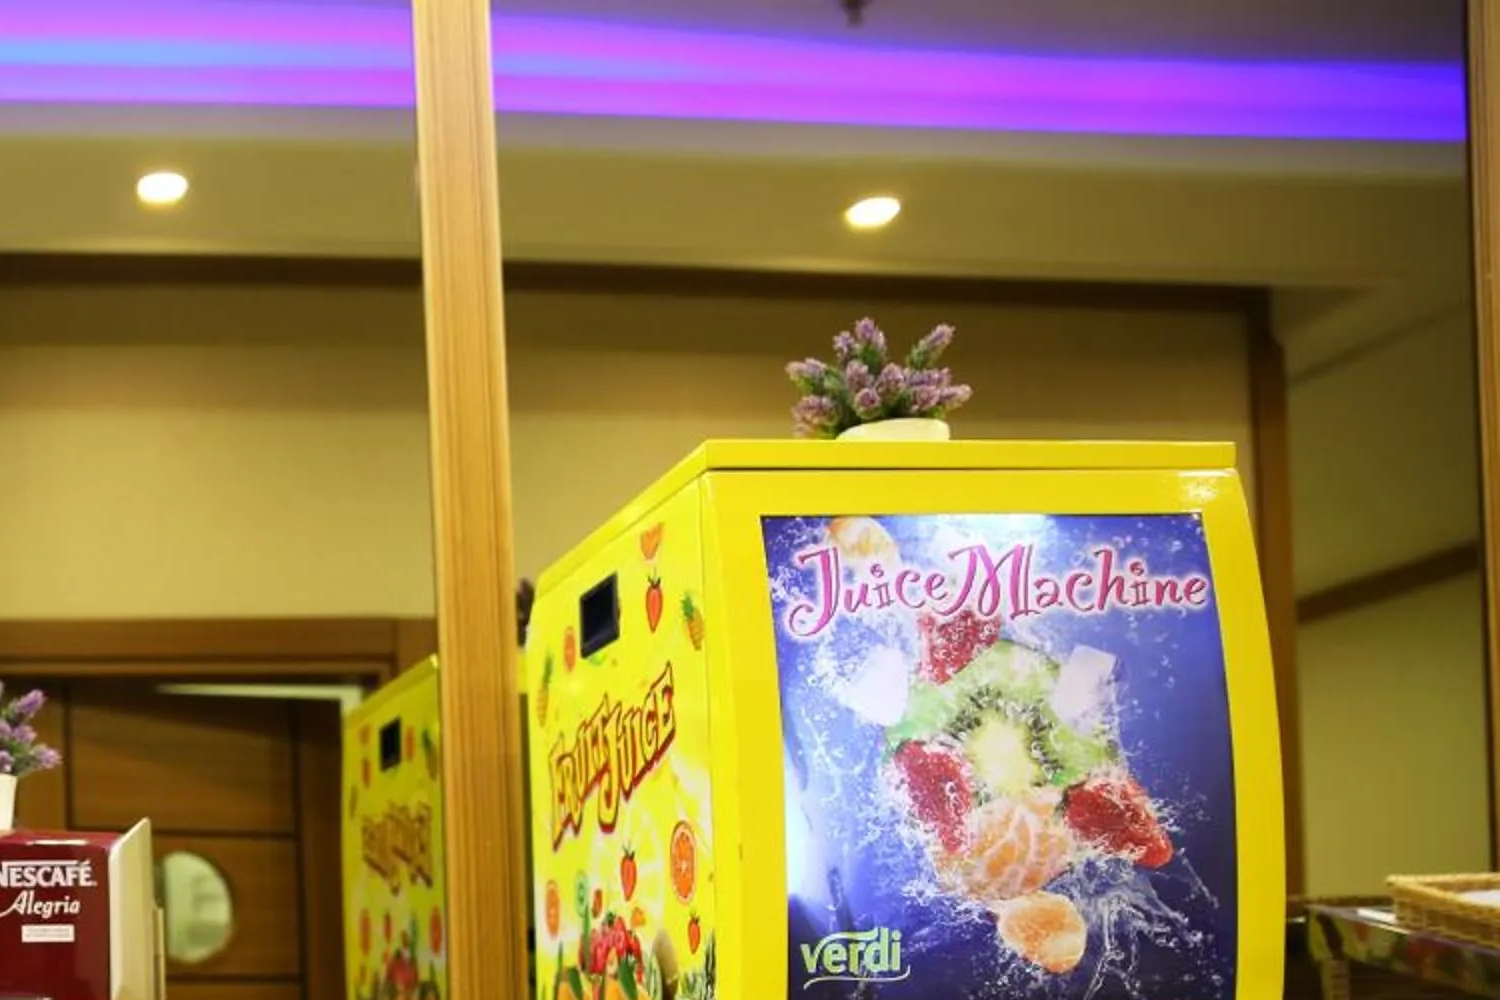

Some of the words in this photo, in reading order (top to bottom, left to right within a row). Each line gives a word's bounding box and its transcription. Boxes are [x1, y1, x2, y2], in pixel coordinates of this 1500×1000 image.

[789, 544, 950, 637] Juice
[931, 542, 1208, 621] Machine
[598, 661, 676, 834] JUICE
[800, 926, 902, 974] verdi
